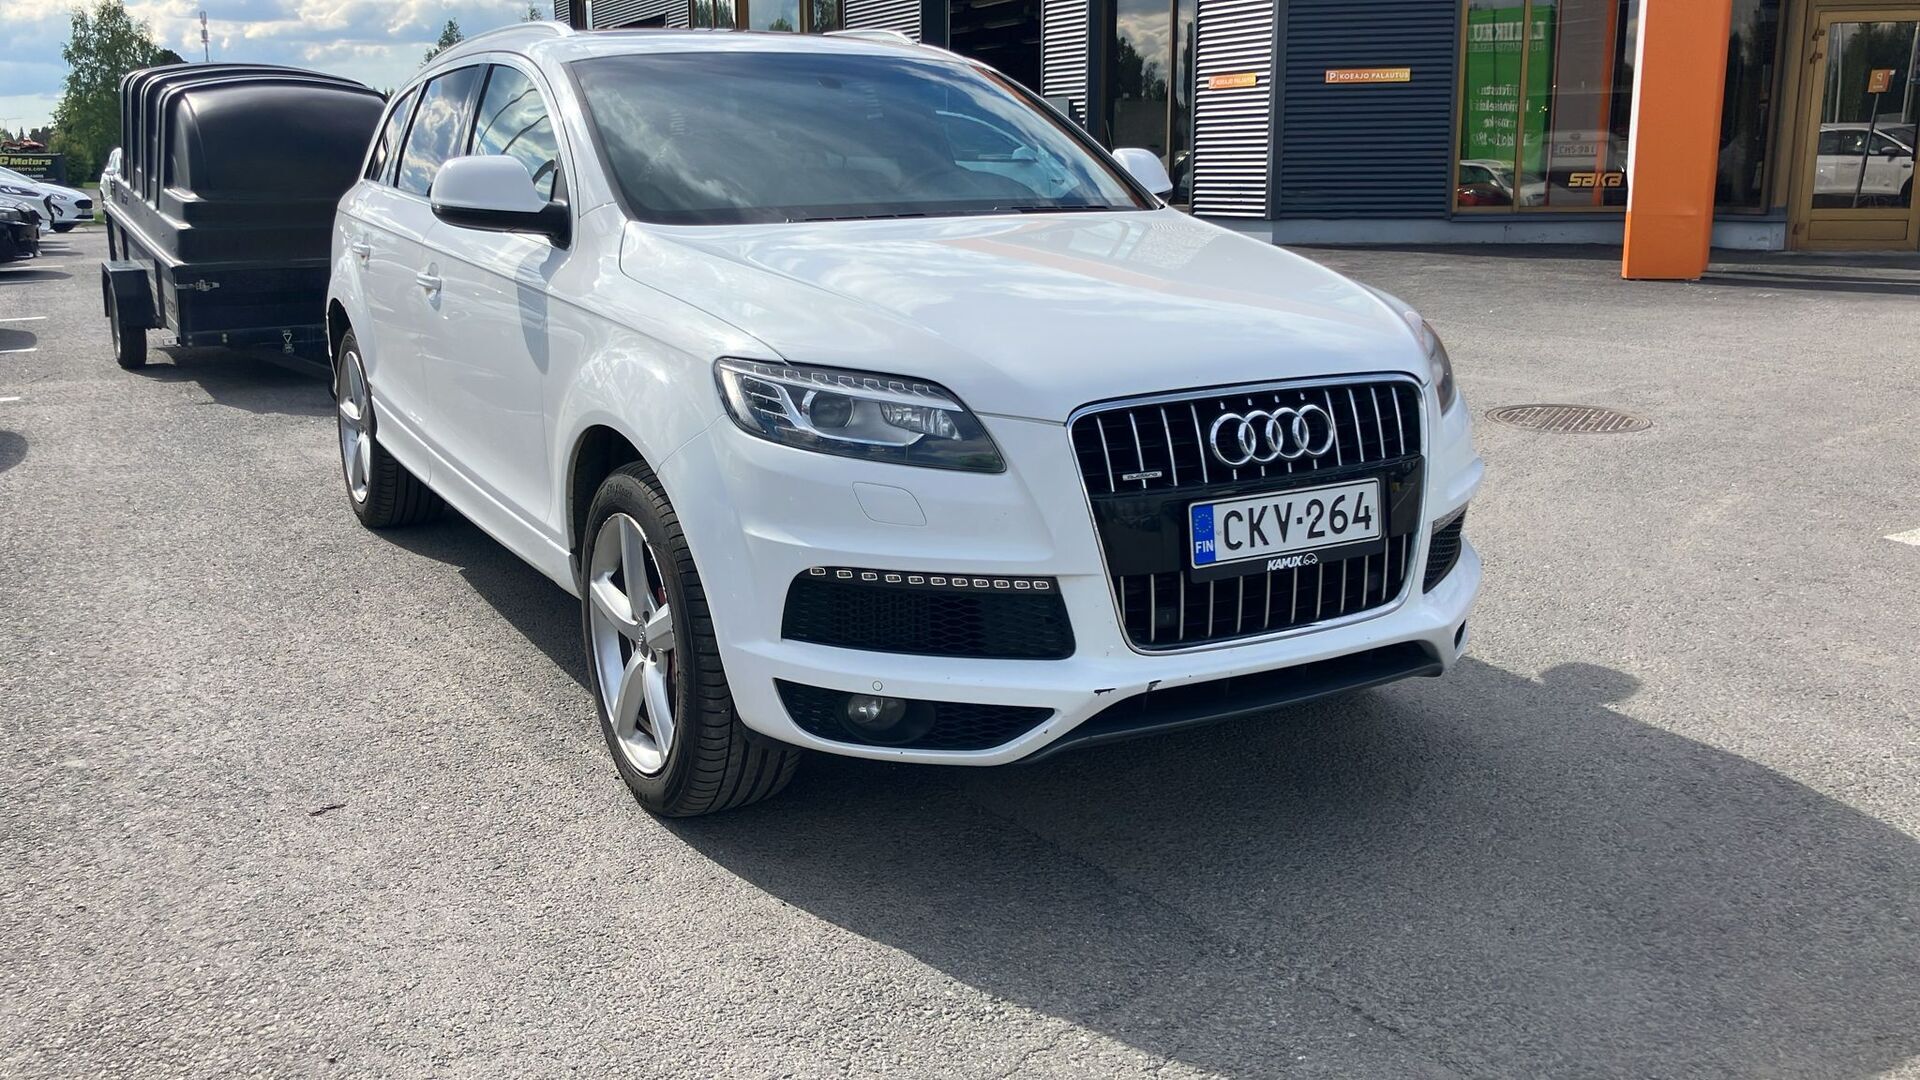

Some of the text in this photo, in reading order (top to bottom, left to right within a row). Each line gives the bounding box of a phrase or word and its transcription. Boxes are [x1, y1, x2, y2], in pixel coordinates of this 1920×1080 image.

[10, 157, 52, 165] Motors
[1223, 491, 1372, 551] CKV-264
[1195, 539, 1214, 554] FIN
[1266, 554, 1304, 571] KAMUX
